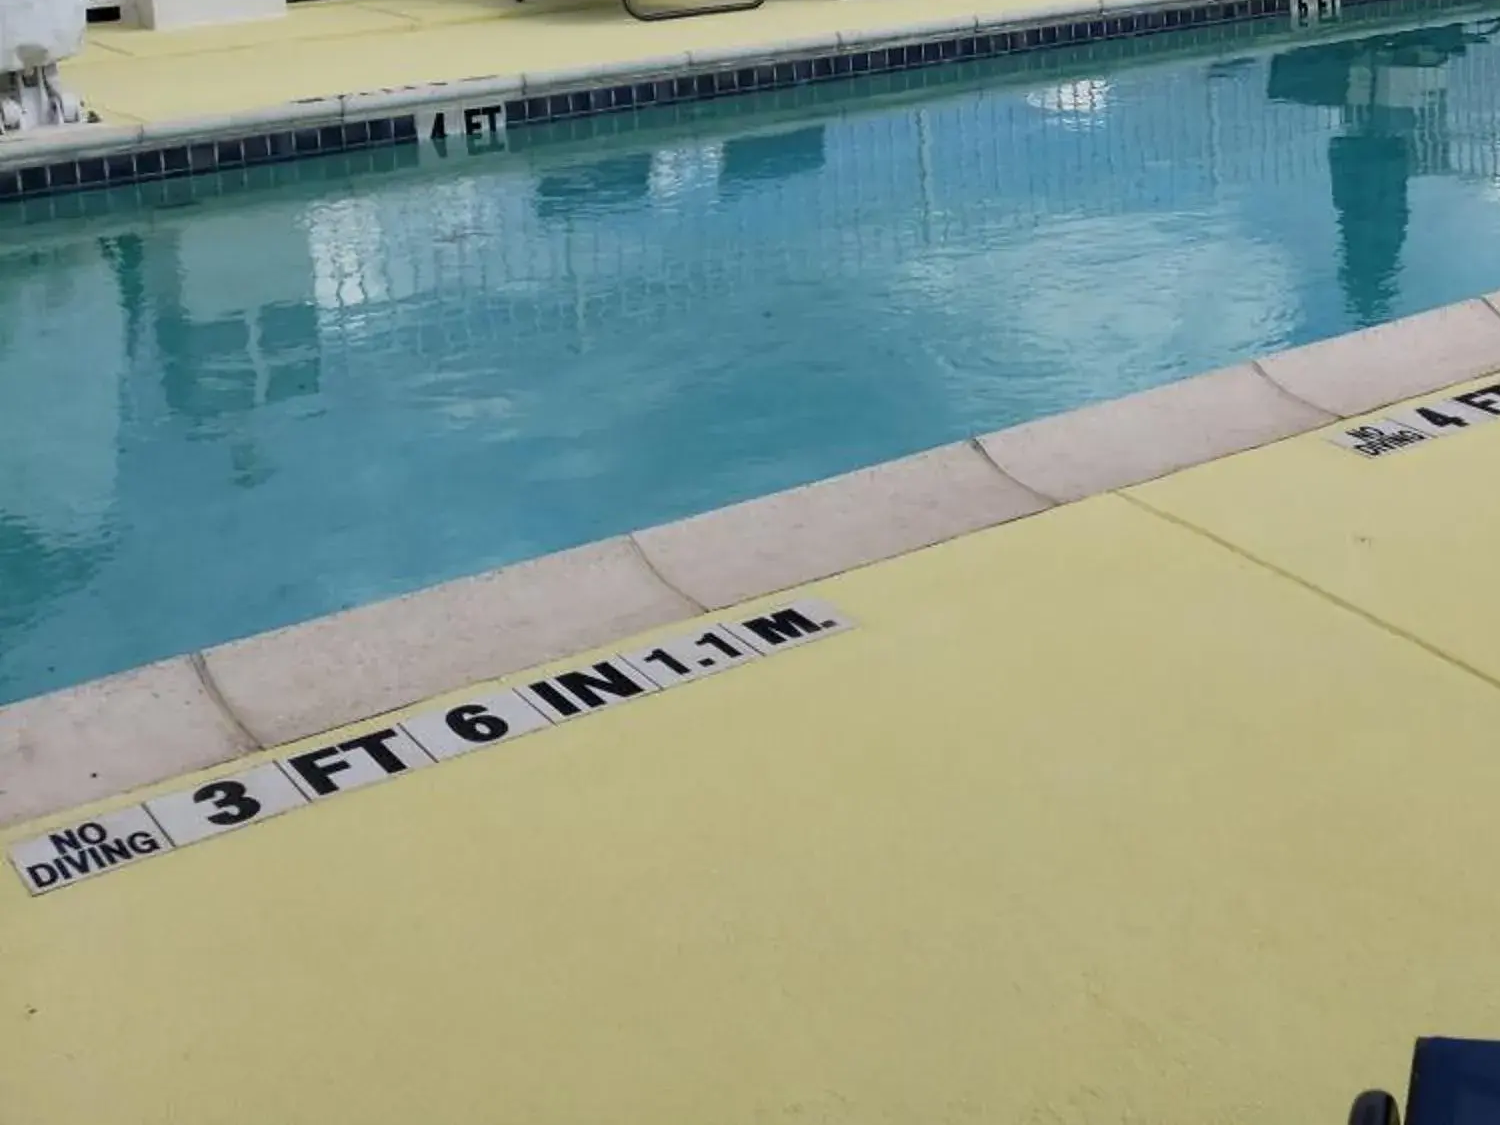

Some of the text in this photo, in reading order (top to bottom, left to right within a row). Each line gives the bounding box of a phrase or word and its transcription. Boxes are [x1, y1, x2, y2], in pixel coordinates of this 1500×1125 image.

[464, 105, 501, 135] FT
[1414, 406, 1470, 428] 4
[193, 607, 836, 825] 3 FT 6 IN 1.1 M.
[49, 822, 107, 855] NO
[26, 831, 160, 888] DIVING
